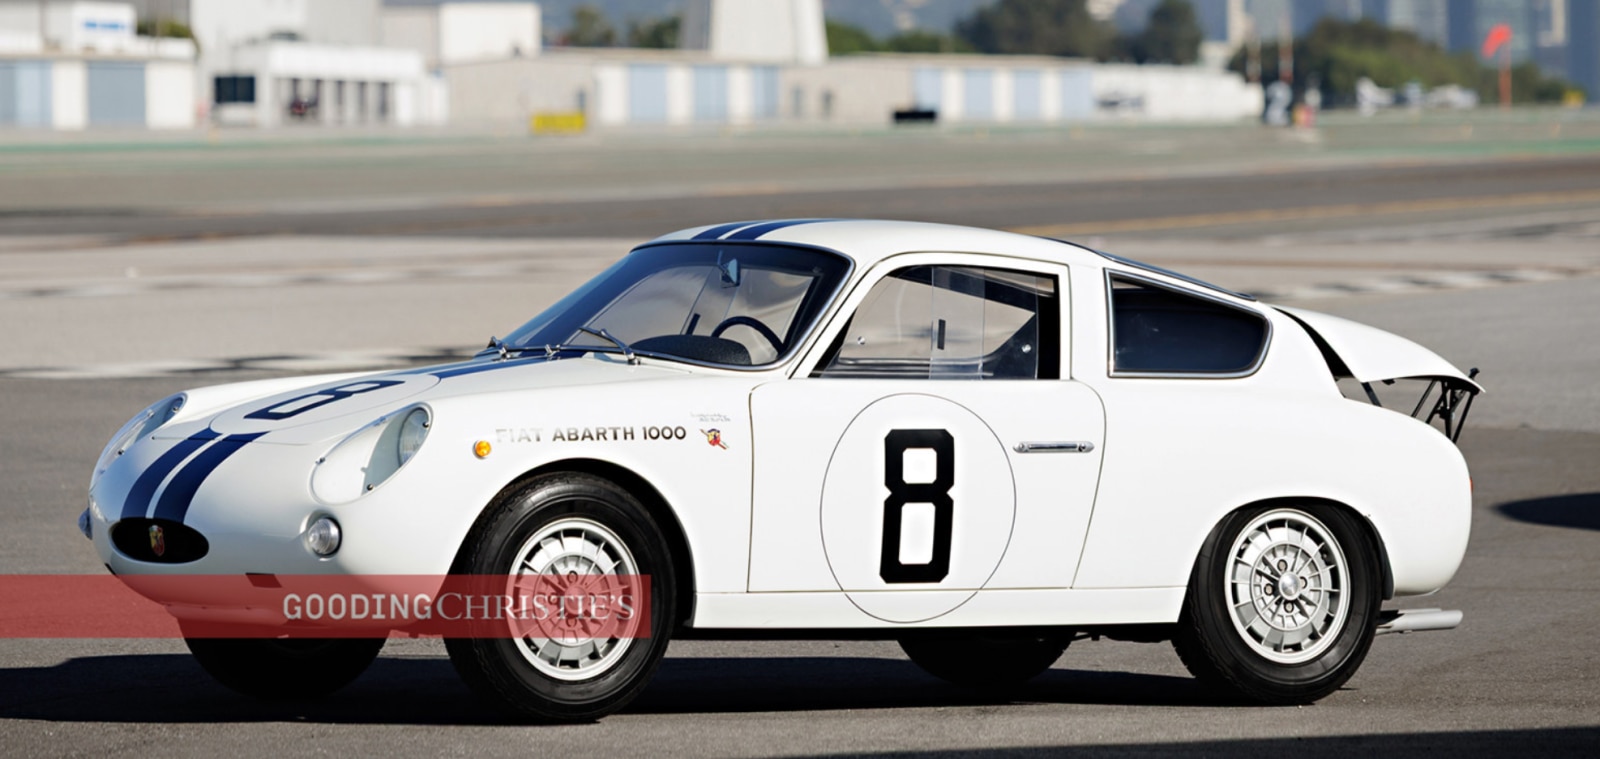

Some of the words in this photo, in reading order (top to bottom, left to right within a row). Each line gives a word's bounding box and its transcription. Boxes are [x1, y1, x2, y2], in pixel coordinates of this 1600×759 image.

[243, 380, 406, 420] 8
[495, 428, 543, 443] FIAT
[552, 426, 635, 442] ABARTH
[642, 425, 687, 441] 1000
[879, 428, 955, 584] 8
